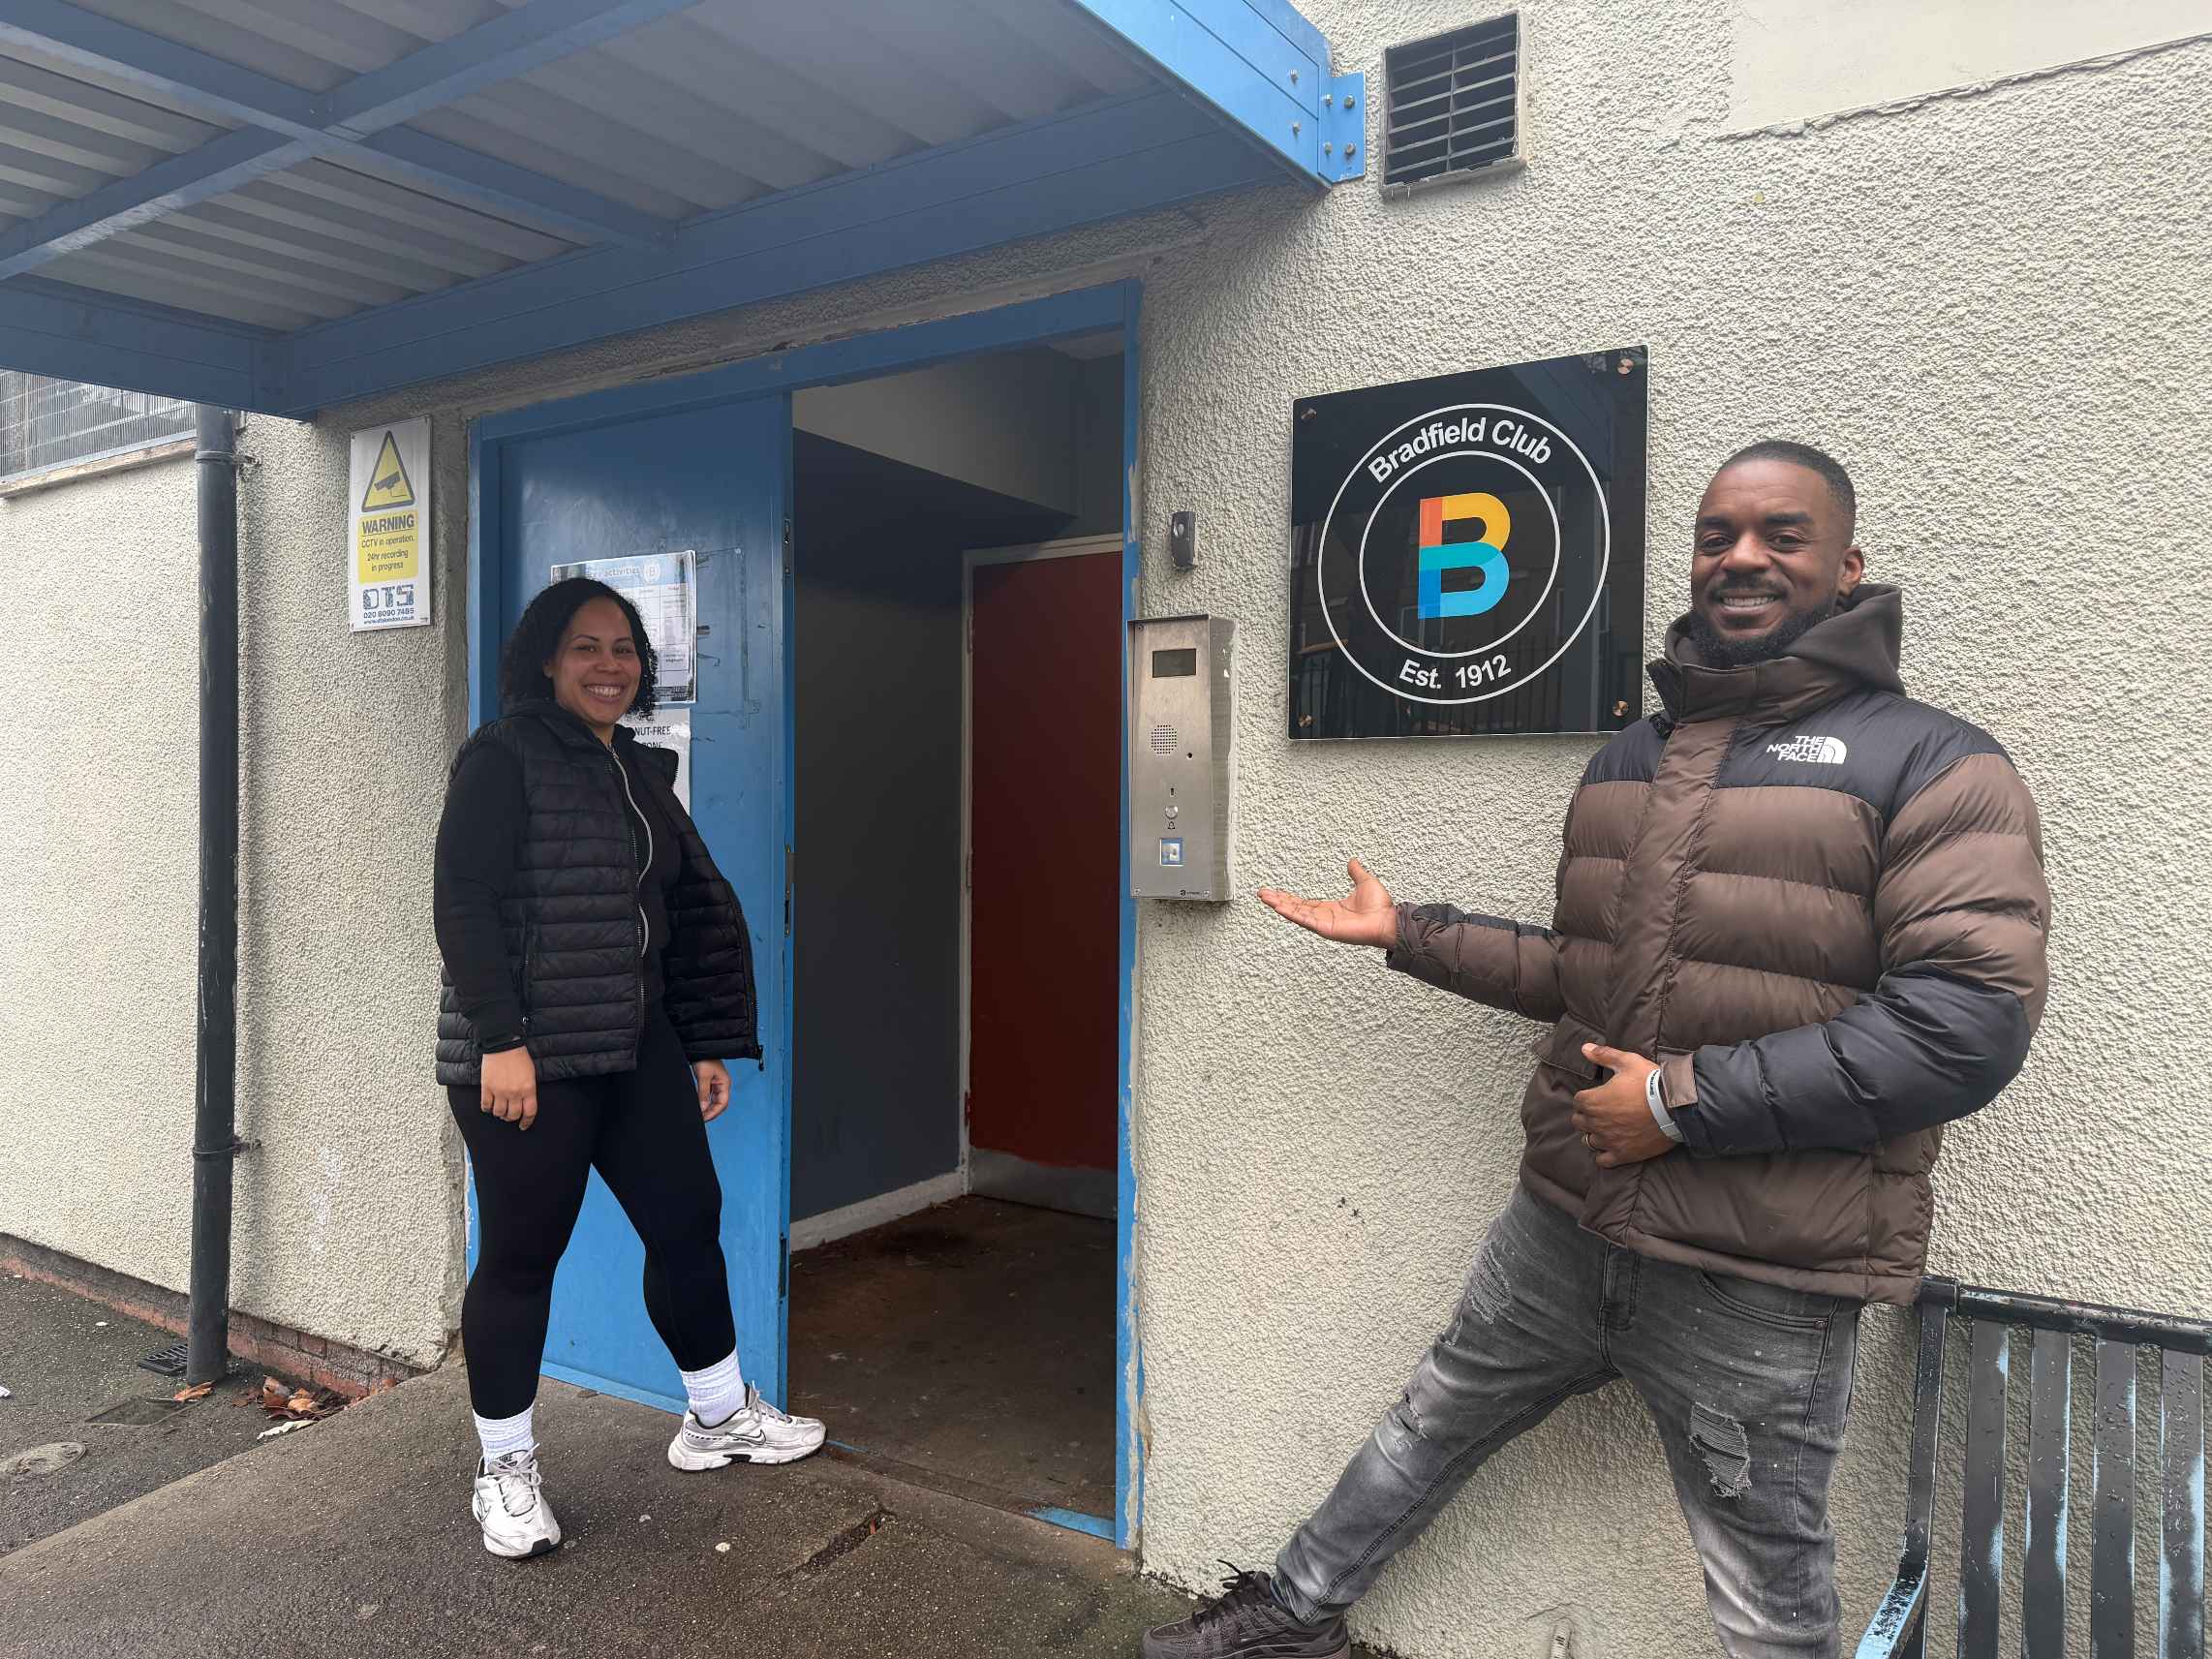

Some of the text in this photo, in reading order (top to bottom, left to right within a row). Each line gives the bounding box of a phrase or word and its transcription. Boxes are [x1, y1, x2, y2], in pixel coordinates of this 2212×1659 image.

[1367, 416, 1551, 483] Bradfield Club
[362, 513, 415, 534] WARNING
[361, 538, 379, 548] CCTV
[367, 549, 409, 562] 24hr recording
[1418, 492, 1511, 620] B
[371, 562, 404, 572] in progress
[363, 584, 415, 610] DTS
[1399, 655, 1511, 689] Est. 1912
[634, 725, 671, 736] NUT-FREE
[1795, 735, 1826, 745] THE
[1767, 743, 1822, 753] NORTH
[1777, 752, 1818, 762] FACE
